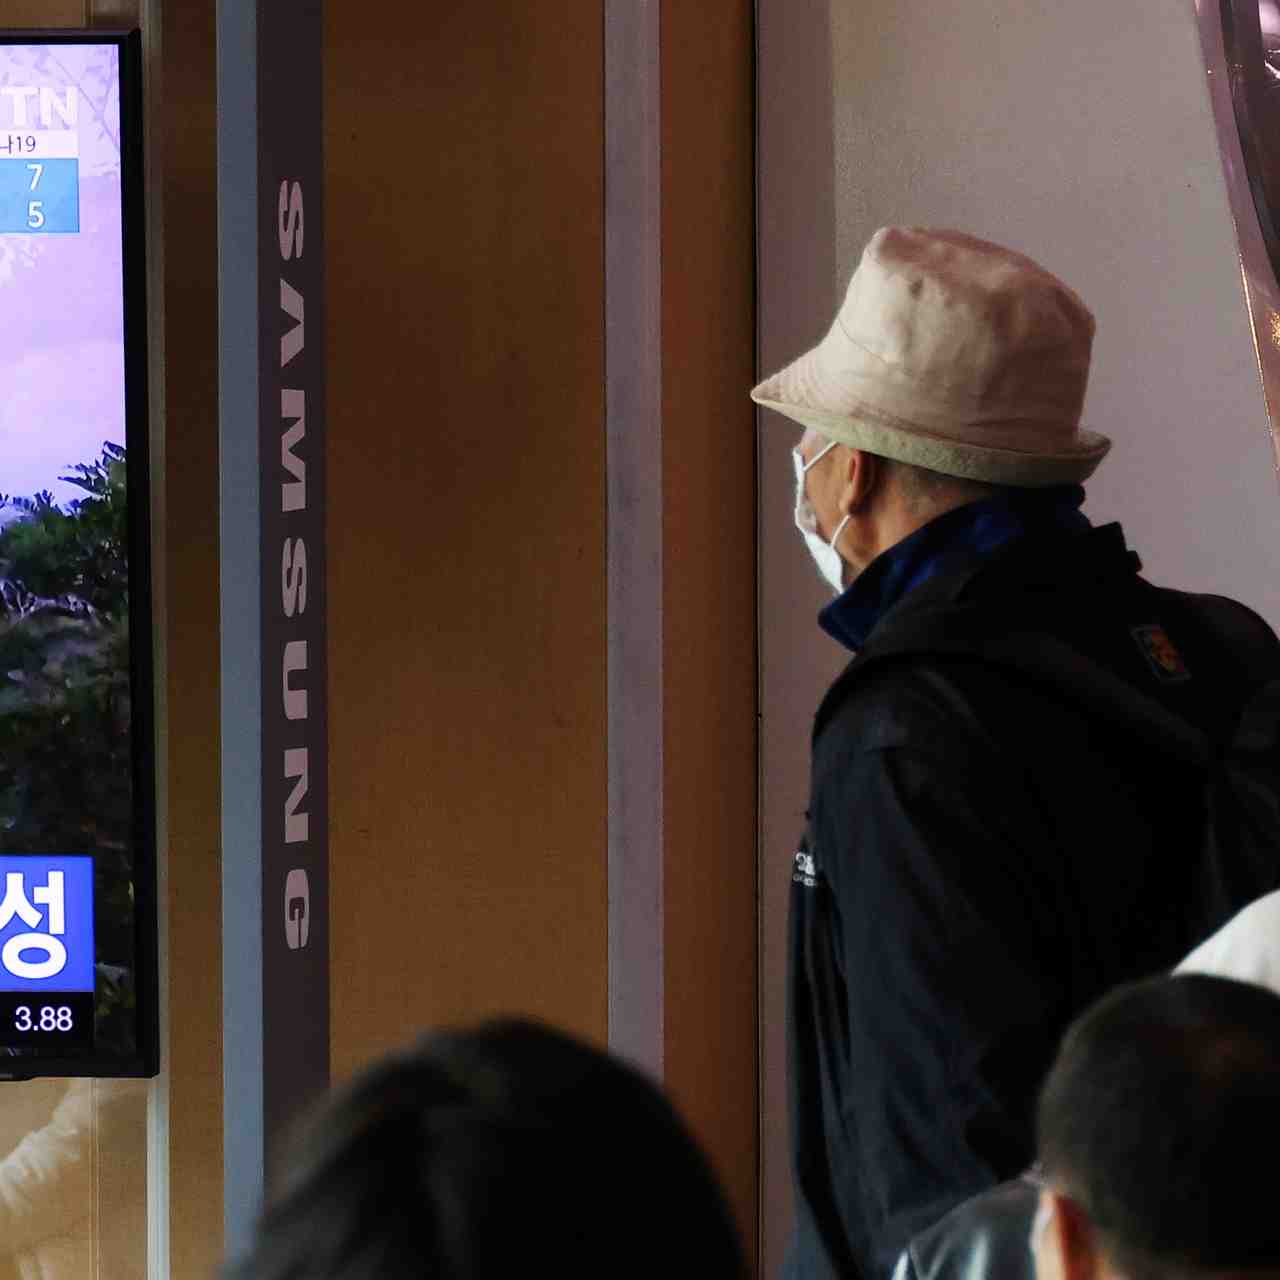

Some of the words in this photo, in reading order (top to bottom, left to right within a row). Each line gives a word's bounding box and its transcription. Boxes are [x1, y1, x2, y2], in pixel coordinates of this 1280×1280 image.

[26, 163, 44, 192] 7
[27, 200, 46, 228] 5
[278, 180, 311, 950] SAMSUNG
[15, 1006, 73, 1031] 3.88
